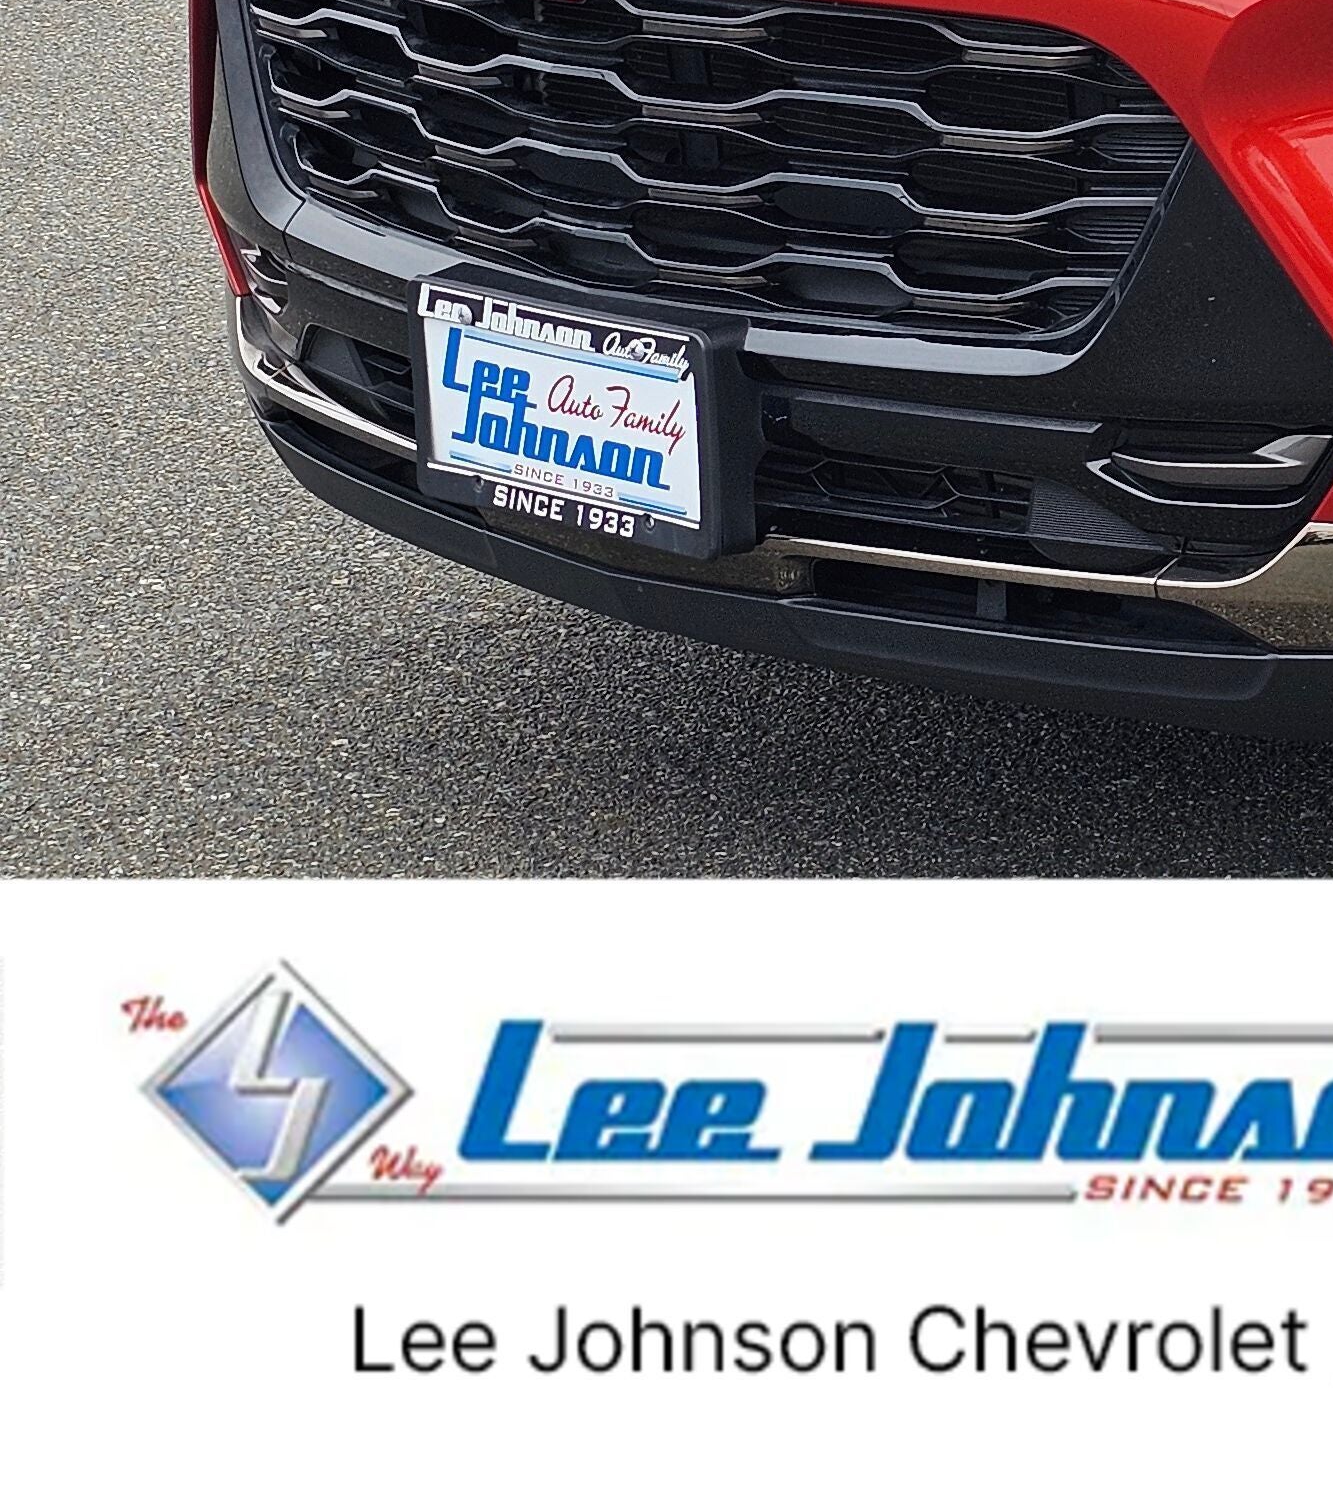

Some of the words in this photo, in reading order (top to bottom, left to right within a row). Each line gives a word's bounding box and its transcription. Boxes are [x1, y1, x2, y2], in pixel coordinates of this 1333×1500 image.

[417, 282, 473, 325] Lee
[475, 297, 596, 353] Johnson
[633, 338, 690, 381] Family
[442, 327, 538, 409] Lee
[547, 374, 604, 421] Auto
[606, 385, 686, 456] Family
[451, 389, 671, 491] Johnson
[492, 483, 564, 521] SINCE
[576, 503, 636, 538] 1933
[513, 464, 564, 487] SINCE
[573, 478, 614, 498] 1933
